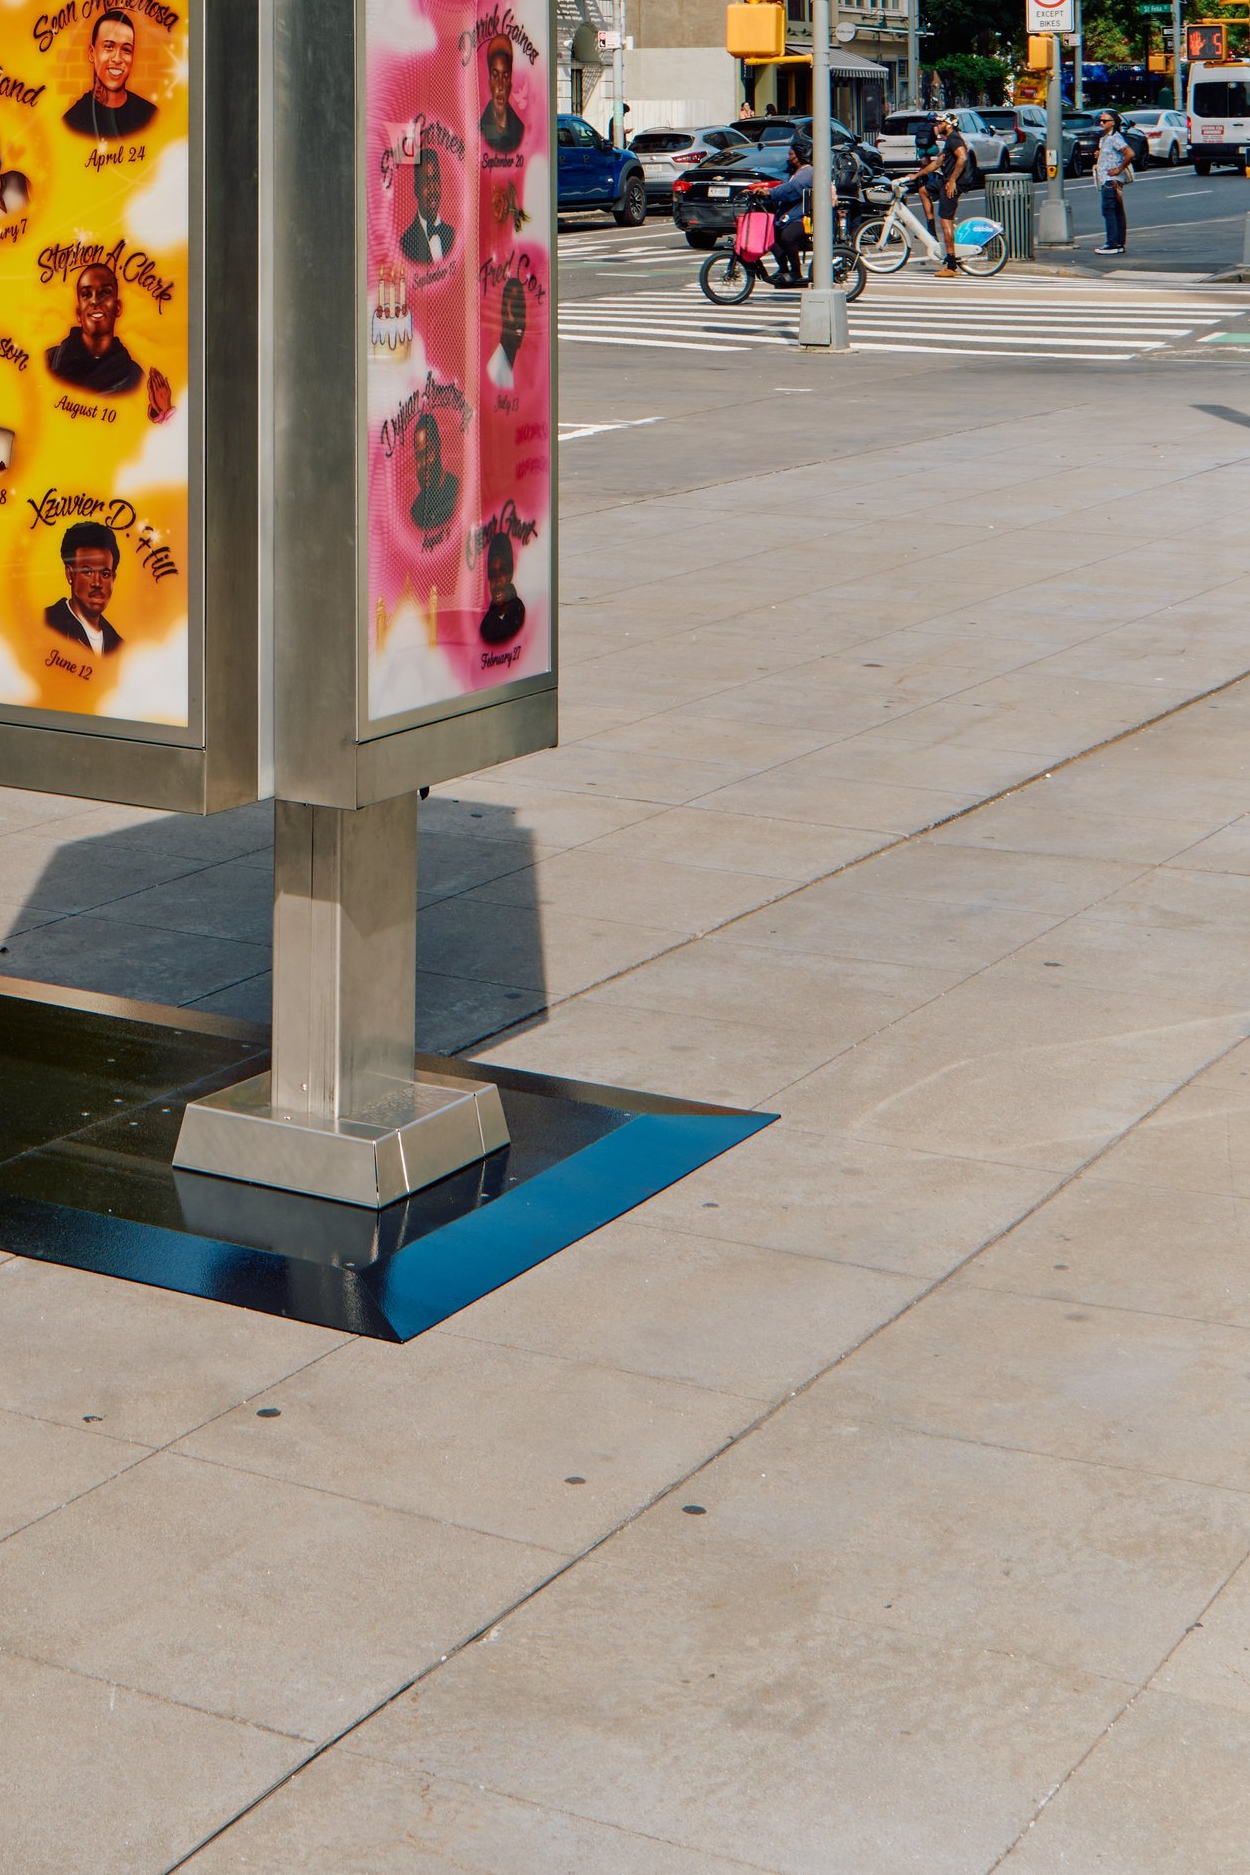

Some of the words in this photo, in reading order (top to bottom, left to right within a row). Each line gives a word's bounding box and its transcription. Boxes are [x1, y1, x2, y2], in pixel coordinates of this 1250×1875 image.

[33, 0, 77, 53] Sean
[1036, 10, 1064, 18] EXCEPT
[502, 7, 540, 66] Gaines
[1212, 32, 1222, 55] 5
[84, 145, 124, 173] April
[128, 145, 146, 163] 24
[482, 152, 514, 173] September
[515, 152, 524, 168] 20
[20, 218, 28, 235] 7
[37, 240, 104, 284] Stephon
[105, 238, 127, 273] A.
[123, 251, 174, 316] Clark
[480, 249, 515, 297] Fred
[517, 253, 546, 305] Cox
[54, 395, 98, 419] August
[100, 407, 117, 424] 10
[494, 394, 511, 416] July
[26, 487, 105, 530] Xzavier
[104, 498, 137, 539] D.
[135, 525, 179, 585] Hill
[500, 498, 540, 547] Grant
[44, 649, 77, 673] June
[78, 664, 93, 681] 12
[480, 652, 513, 671] February
[513, 645, 522, 661] 27
